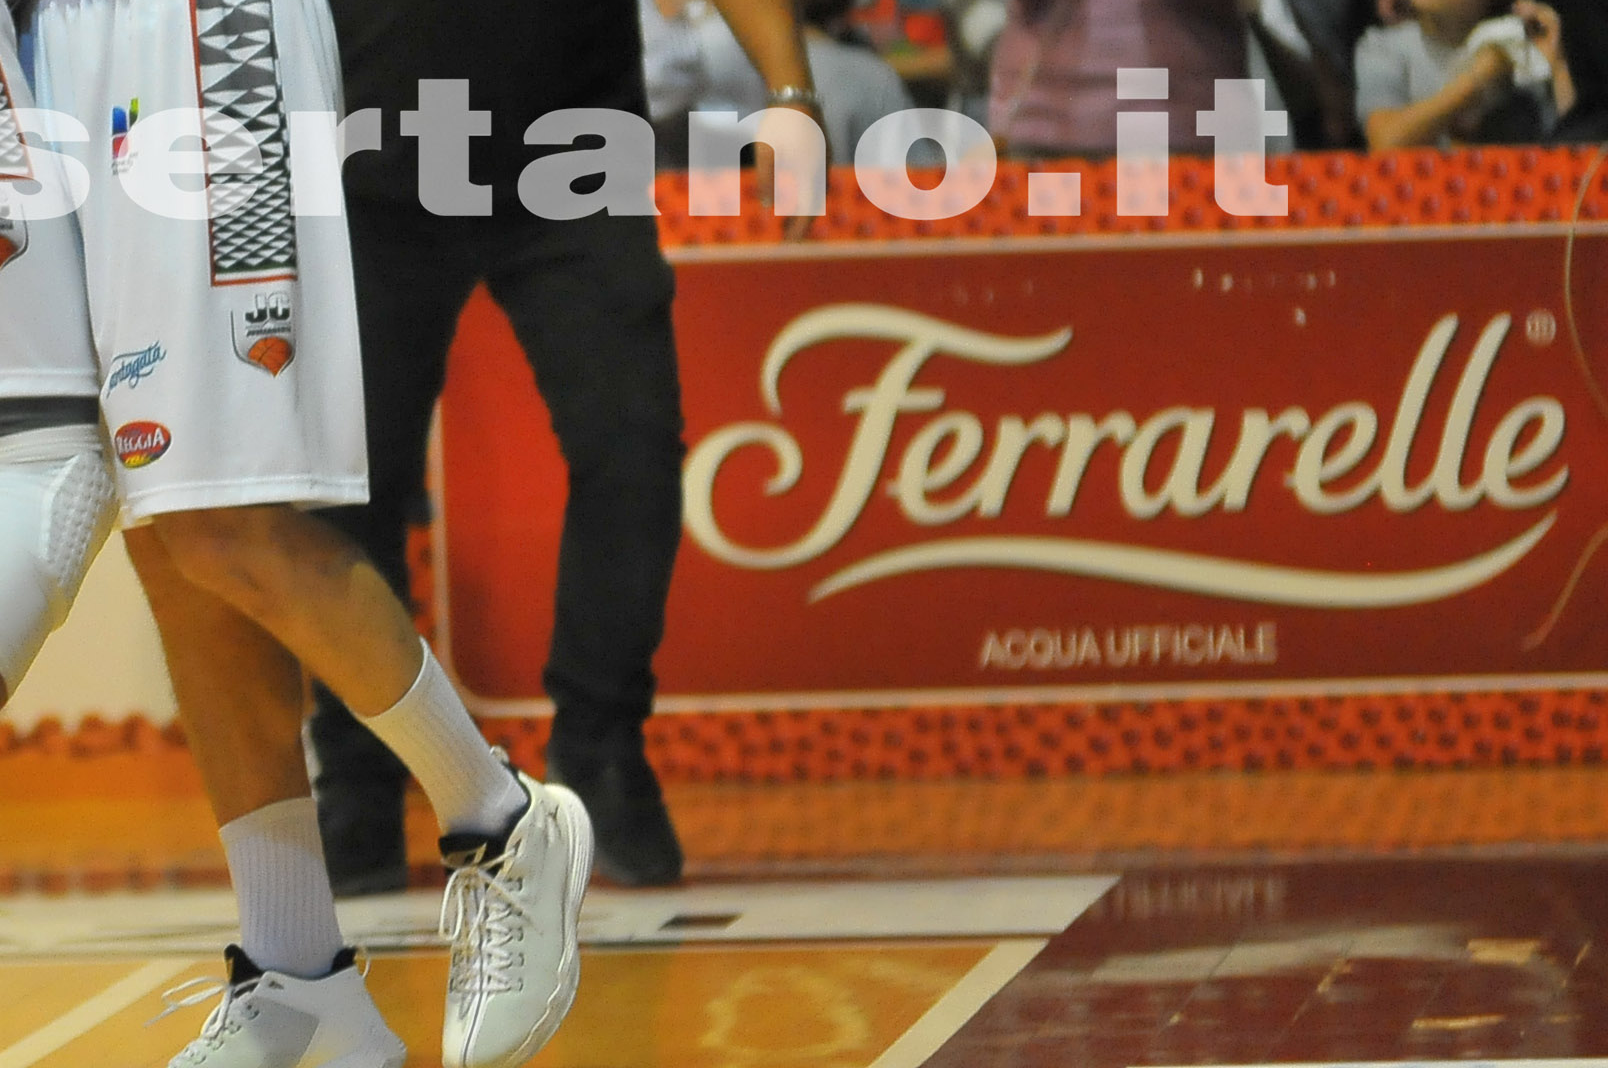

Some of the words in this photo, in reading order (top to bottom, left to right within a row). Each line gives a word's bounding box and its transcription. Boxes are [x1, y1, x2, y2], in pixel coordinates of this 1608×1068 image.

[681, 302, 1569, 570] Ferrarelle
[980, 628, 1102, 671] ACQUA
[1105, 622, 1277, 668] UFFICIALE
